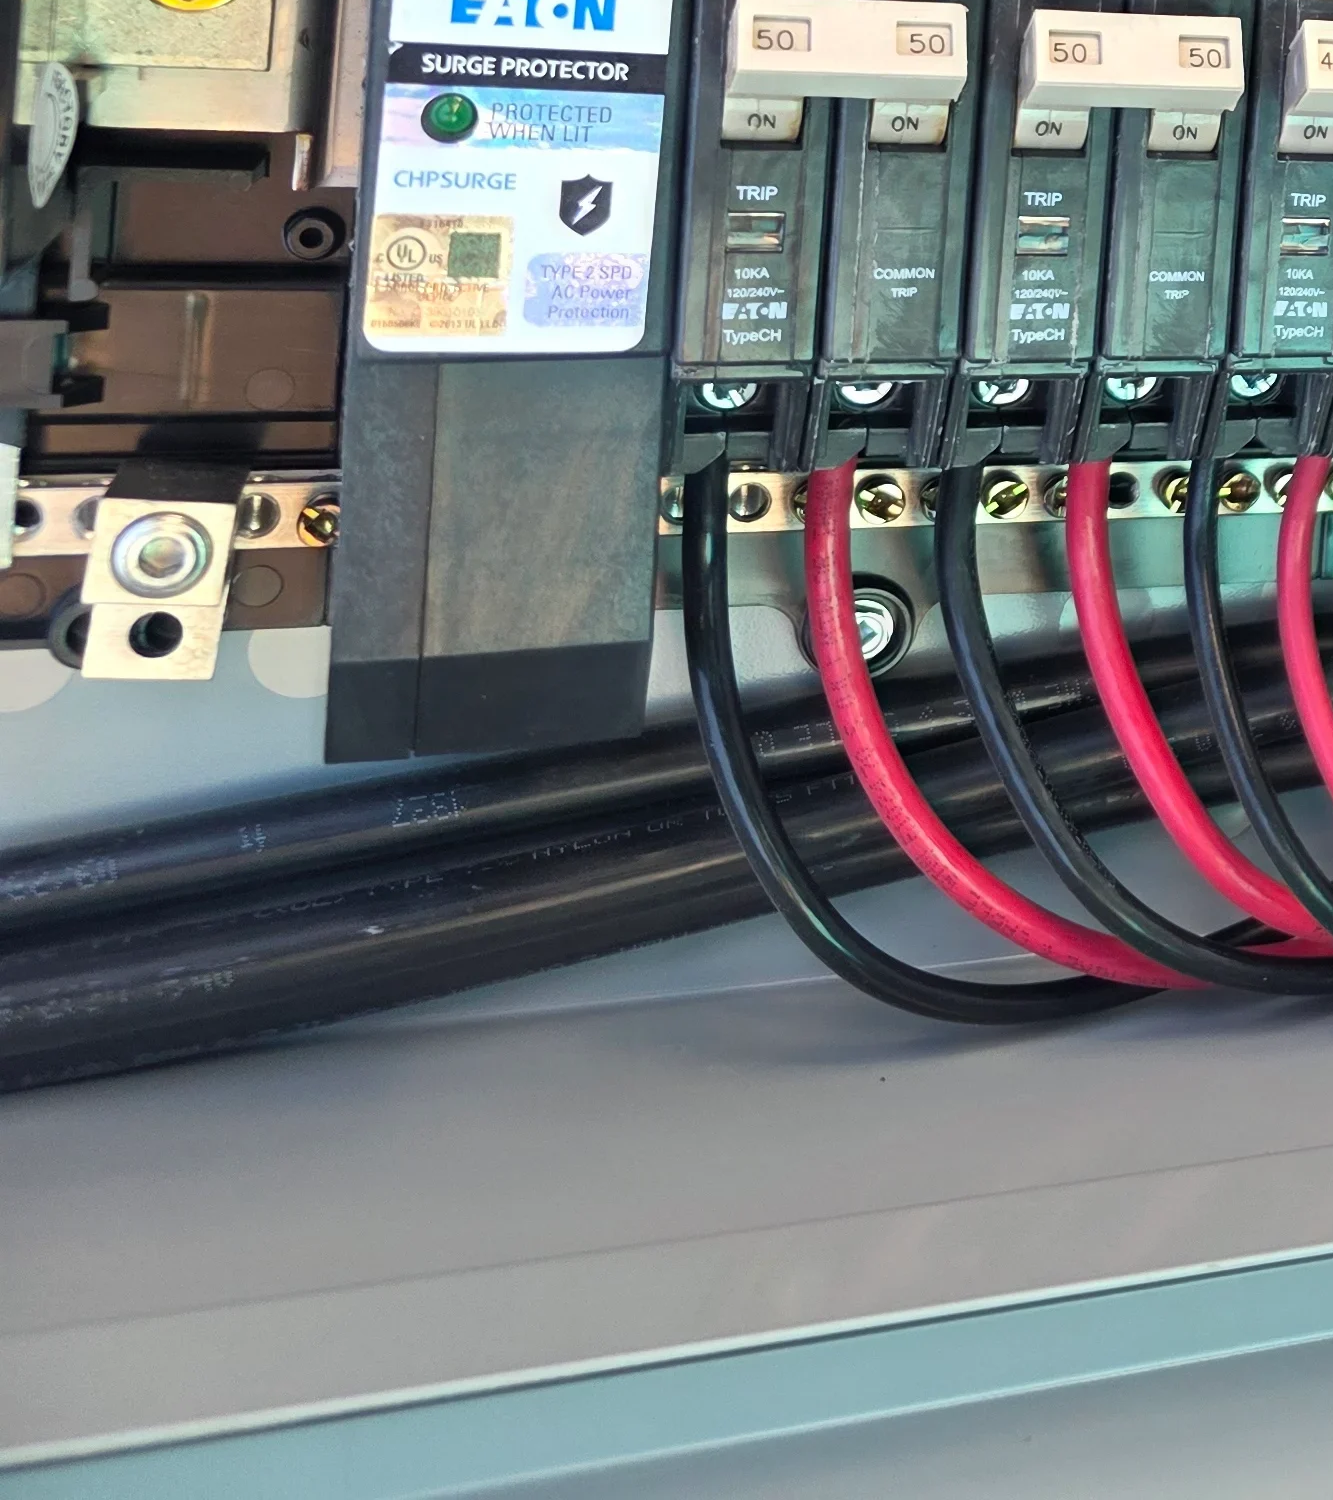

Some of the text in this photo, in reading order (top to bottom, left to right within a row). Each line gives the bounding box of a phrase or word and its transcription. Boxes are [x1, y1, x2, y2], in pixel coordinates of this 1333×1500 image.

[756, 29, 794, 51] 50
[910, 34, 945, 54] 50
[1053, 43, 1087, 63] 50
[1189, 48, 1222, 67] 50
[421, 54, 629, 81] SURGE PROTECTOR
[492, 103, 612, 123] PROTECTED
[748, 113, 777, 130] ON
[891, 116, 919, 132] ON
[488, 123, 593, 142] WHEN LIT
[1303, 125, 1328, 141] ON
[393, 171, 517, 190] CHPSURGE
[736, 186, 778, 201] TRIP
[1024, 192, 1063, 206] TRIP
[1291, 193, 1326, 207] TRIP
[541, 265, 632, 280] TYPE 2 SPD
[734, 268, 770, 280] 10KA
[874, 268, 935, 280] COMMON
[552, 286, 632, 302] AC Power
[891, 287, 918, 298] TRIP
[547, 306, 629, 320] Protection
[722, 303, 787, 320] EATON
[1273, 302, 1328, 317] EATON
